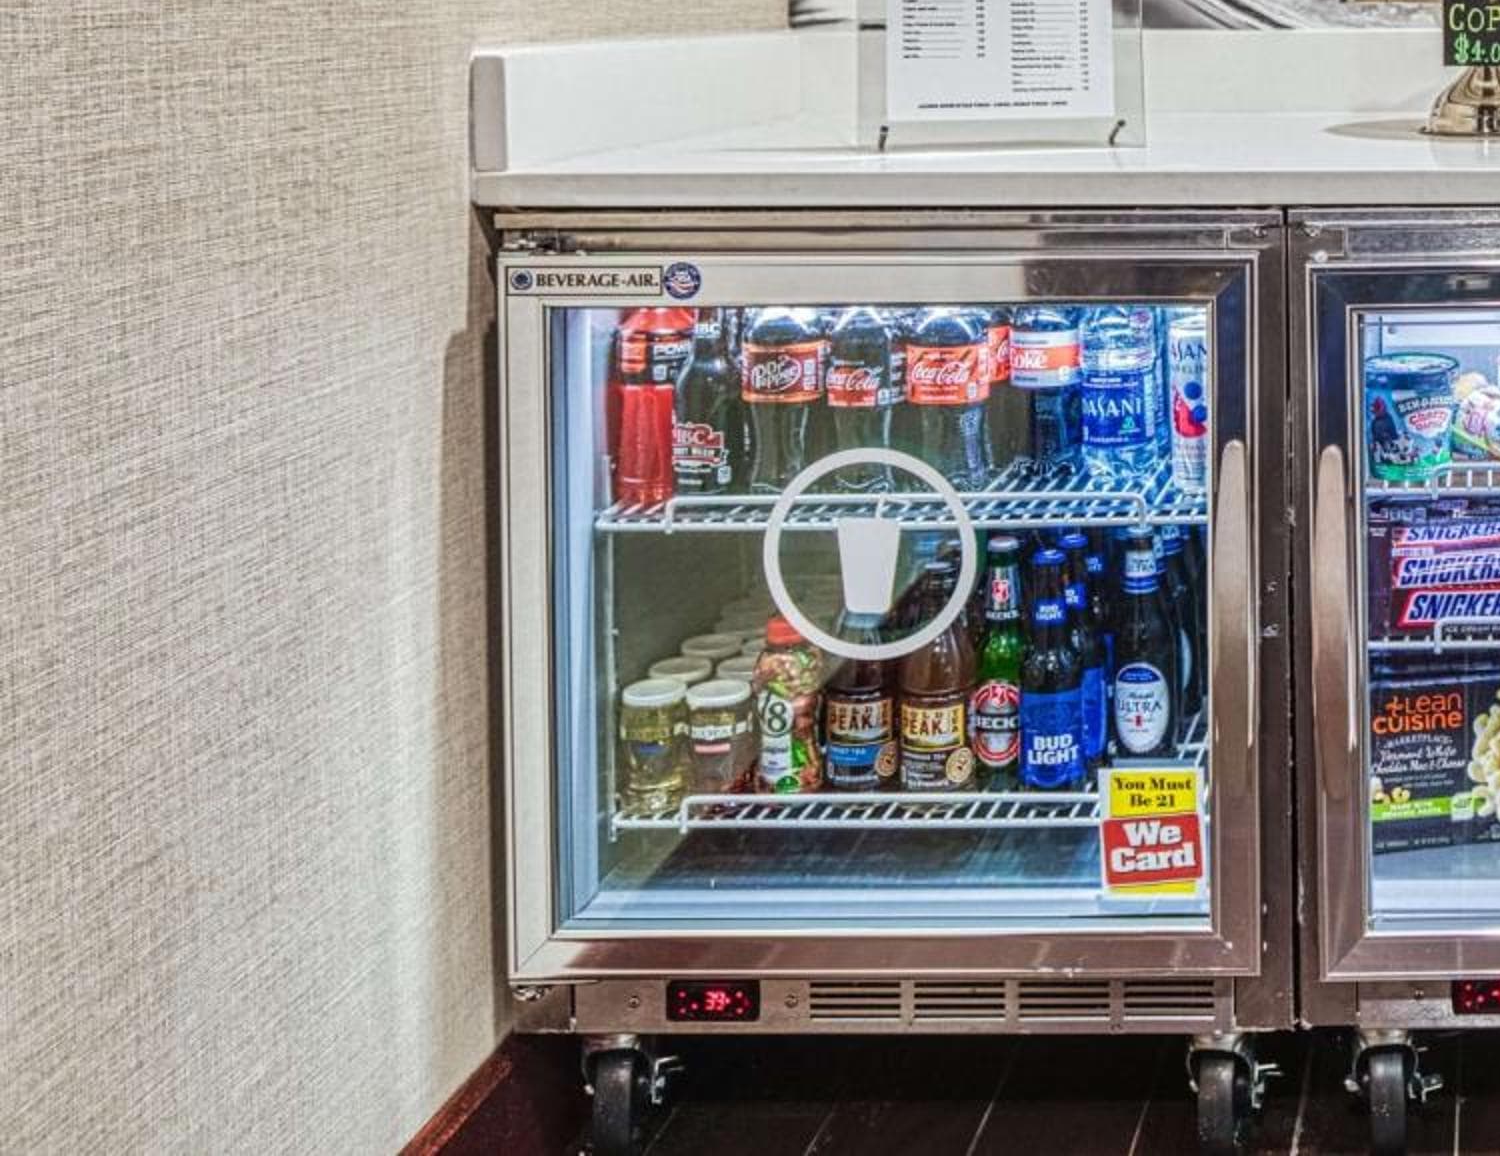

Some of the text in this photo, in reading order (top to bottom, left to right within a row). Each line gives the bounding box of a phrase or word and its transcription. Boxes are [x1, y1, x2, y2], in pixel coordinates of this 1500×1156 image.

[1033, 733, 1074, 752] BUD
[1027, 745, 1080, 766] LIGHT
[1114, 776, 1192, 791] You Must
[1130, 794, 1175, 807] Be 21
[1121, 820, 1183, 847] We
[1110, 841, 1198, 873] Card
